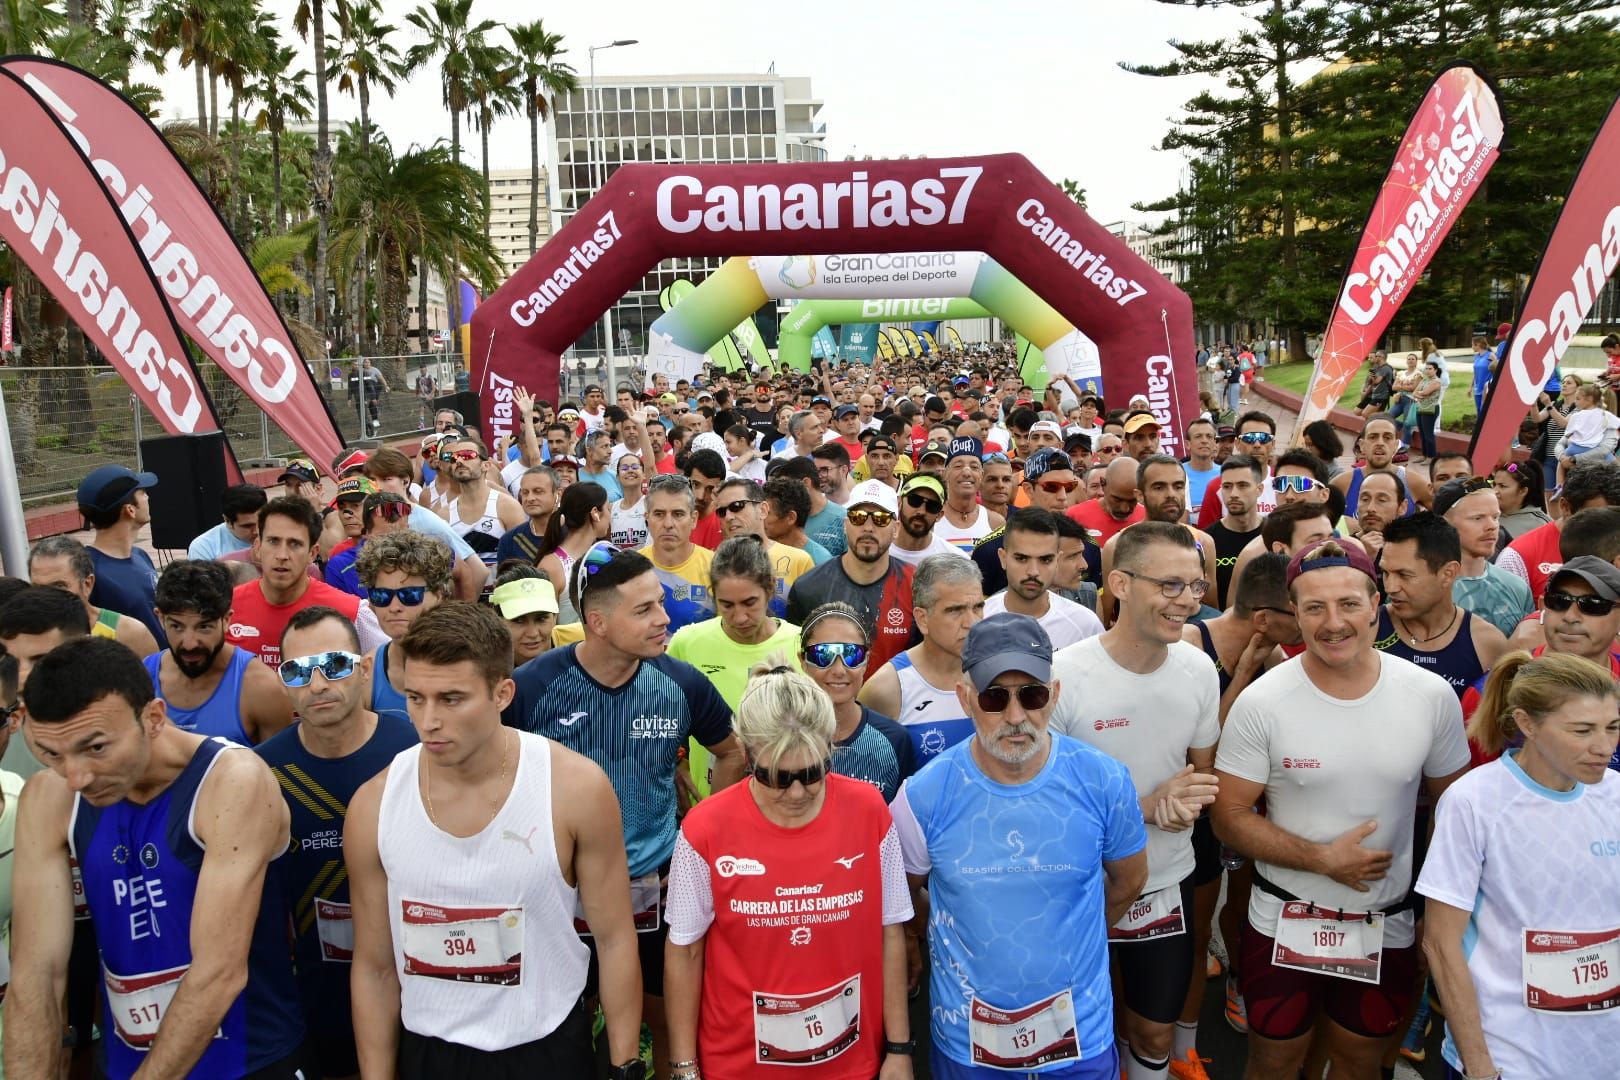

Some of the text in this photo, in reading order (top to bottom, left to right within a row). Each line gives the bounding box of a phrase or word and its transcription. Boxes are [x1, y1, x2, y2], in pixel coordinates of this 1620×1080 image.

[1460, 141, 1493, 187] Canarias
[657, 166, 983, 234] Canarias7
[1339, 90, 1483, 325] Canarias7
[1016, 198, 1147, 306] Canarias7
[510, 210, 622, 327] Canarias7
[824, 252, 955, 271] Gran Canaria
[823, 270, 957, 284] Isla Europea del Deporte
[862, 298, 955, 317] Binter
[611, 527, 647, 538] unning
[884, 626, 907, 634] Redes
[632, 714, 678, 730] civitas
[1105, 720, 1130, 728] JEREZ
[311, 829, 338, 839] GRUPO
[1007, 863, 1071, 873] COLLECTION
[775, 884, 823, 896] Canarias7
[730, 890, 863, 915] CARRERA DE LAS EMPRESAS
[747, 909, 850, 927] LAS PALMAS DE GRAN CANARIA
[444, 938, 476, 956] 394
[1313, 931, 1345, 946] 1807
[1572, 960, 1608, 984] 1795
[1530, 991, 1539, 1000] 11
[129, 1004, 160, 1024] 517
[805, 1021, 823, 1039] 16
[1011, 1029, 1036, 1048] 137
